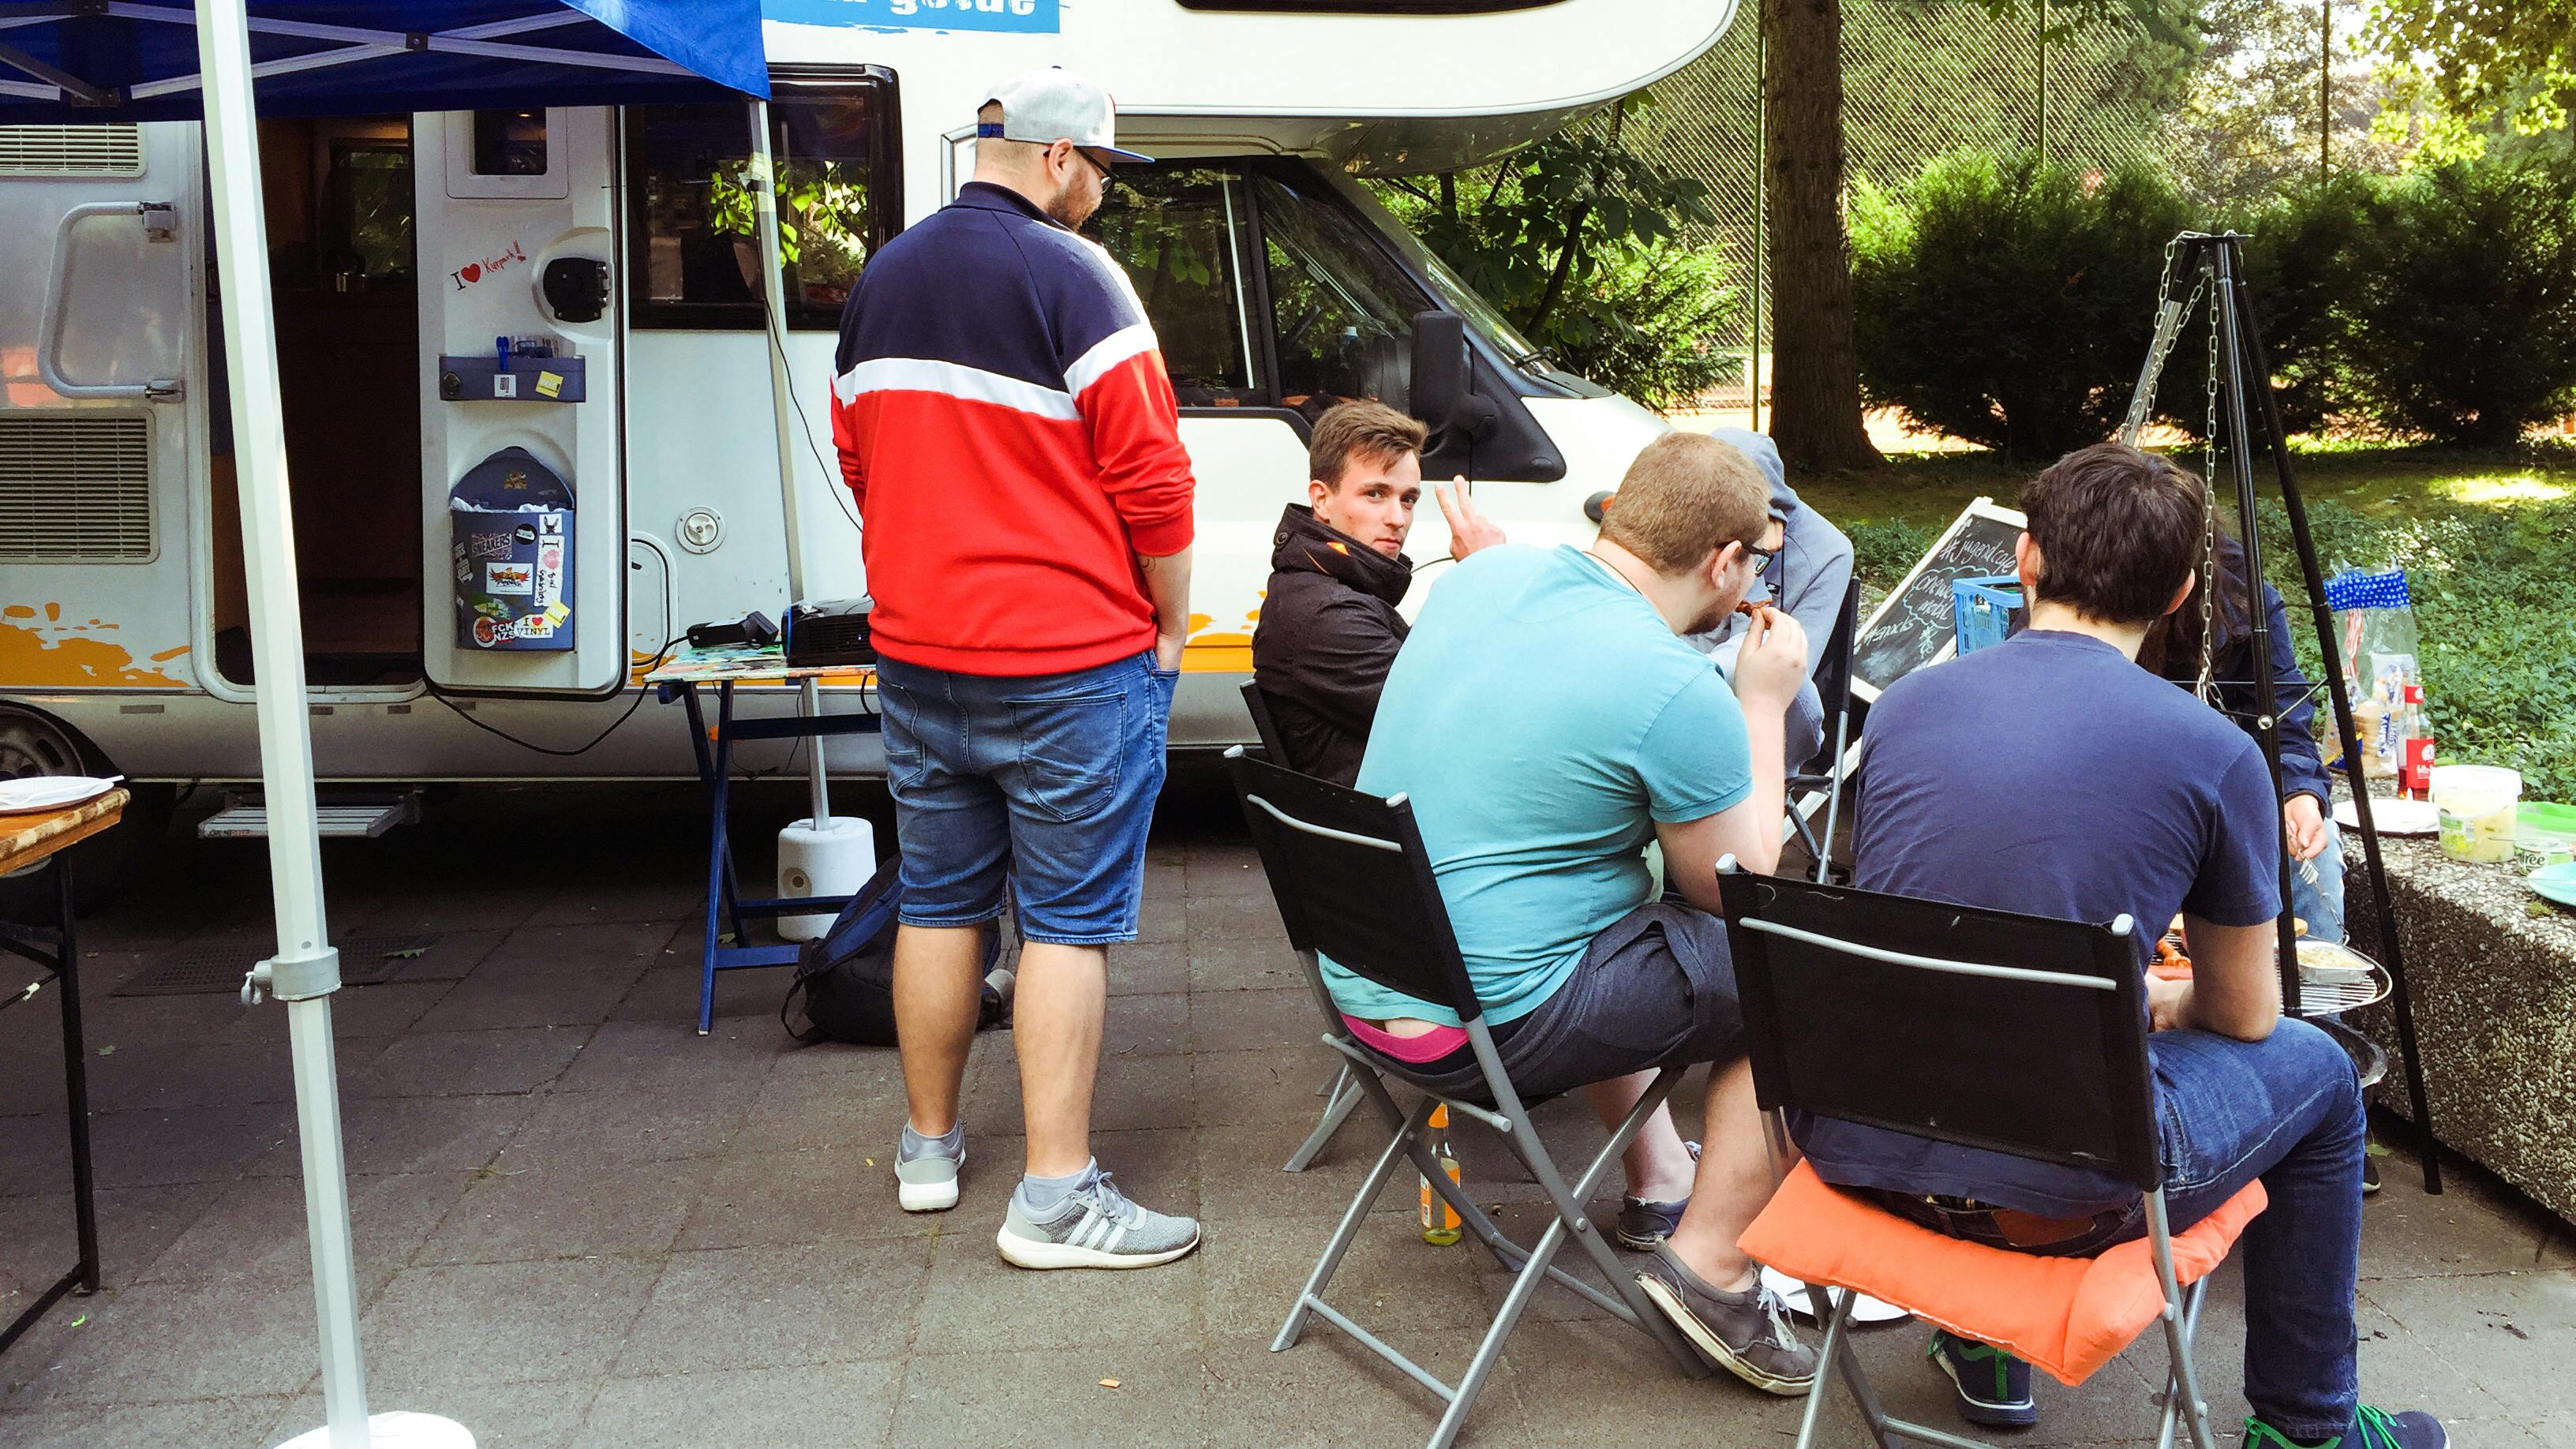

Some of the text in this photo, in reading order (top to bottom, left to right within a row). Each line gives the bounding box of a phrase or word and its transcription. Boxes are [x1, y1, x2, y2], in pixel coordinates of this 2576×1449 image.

[450, 271, 466, 290] I
[473, 534, 511, 556] SNEAKERS
[492, 622, 514, 632] FCK
[517, 627, 550, 636] VINYL
[493, 631, 515, 642] NZS
